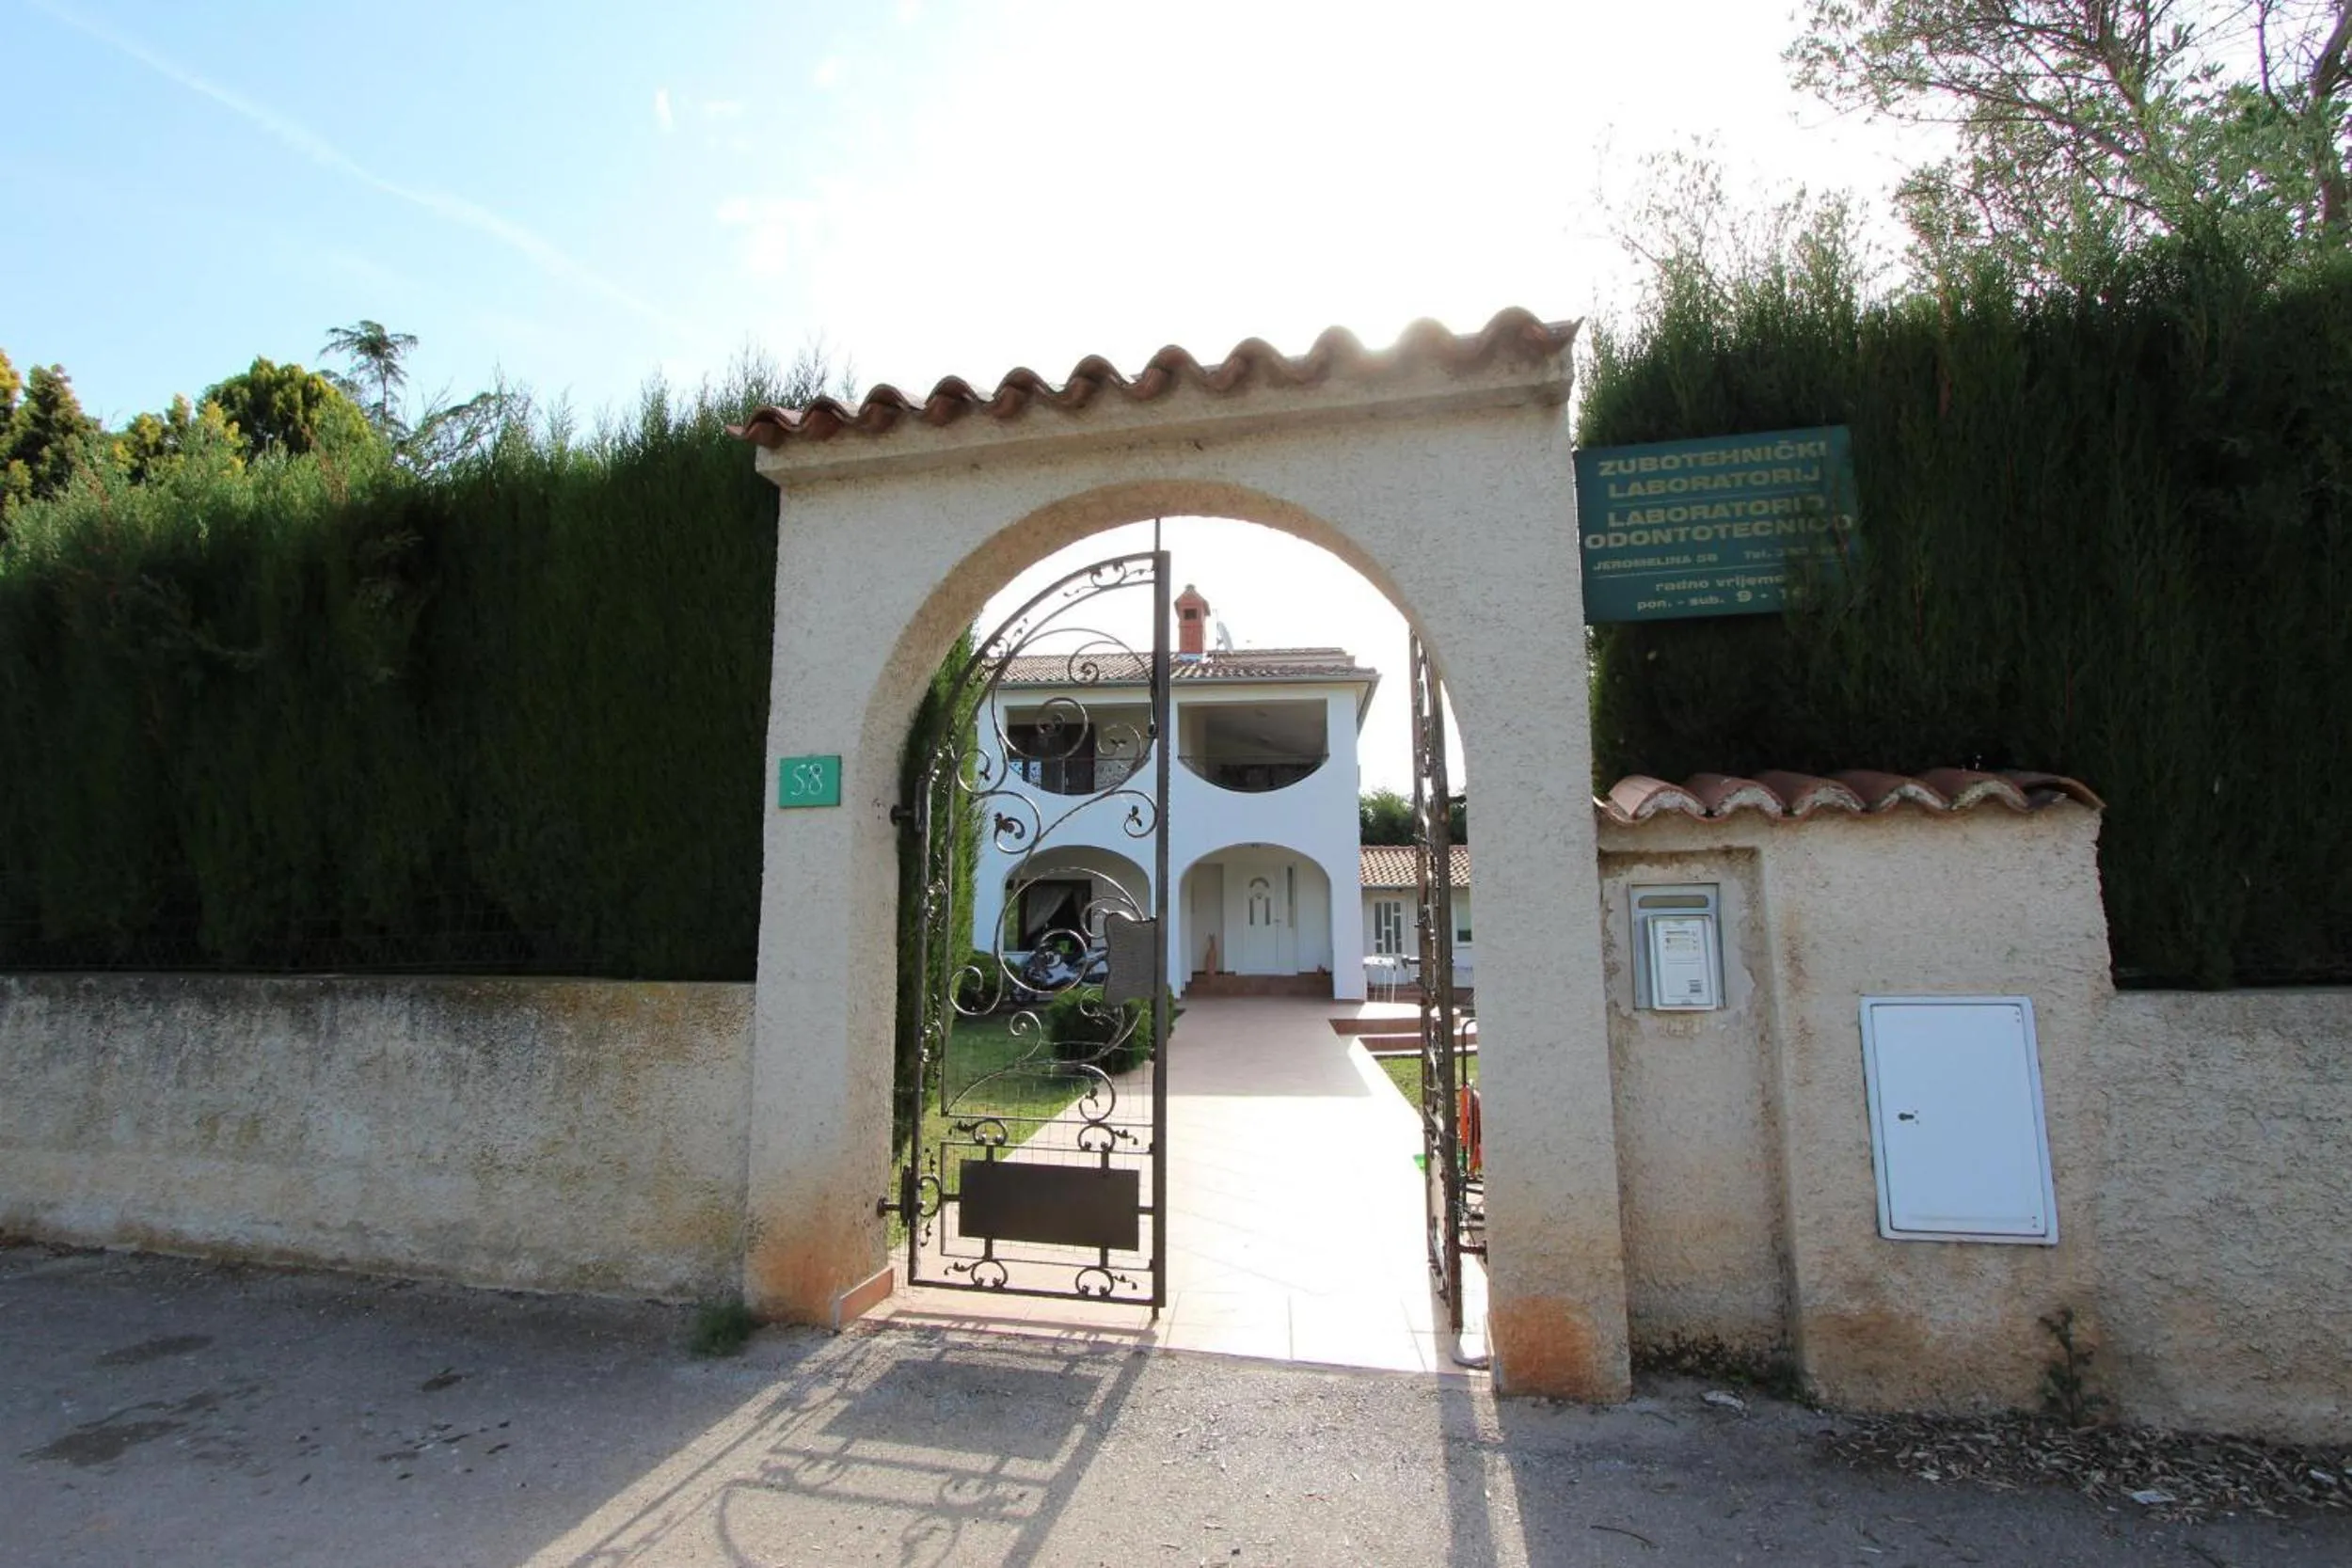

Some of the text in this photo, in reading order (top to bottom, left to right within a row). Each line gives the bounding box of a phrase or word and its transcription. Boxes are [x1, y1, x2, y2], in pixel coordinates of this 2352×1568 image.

[1598, 439, 1827, 477] ZUBOTEHNIČKI
[1608, 465, 1820, 499] LABORATORIJ
[1608, 494, 1826, 527] LABORATORIO
[1743, 549, 1771, 562] Tel.
[1656, 573, 1785, 592] radno vrijeme
[1637, 597, 1672, 612] pon.
[1689, 595, 1725, 607] sub.
[1737, 590, 1753, 603] 9
[789, 763, 823, 797] 58
